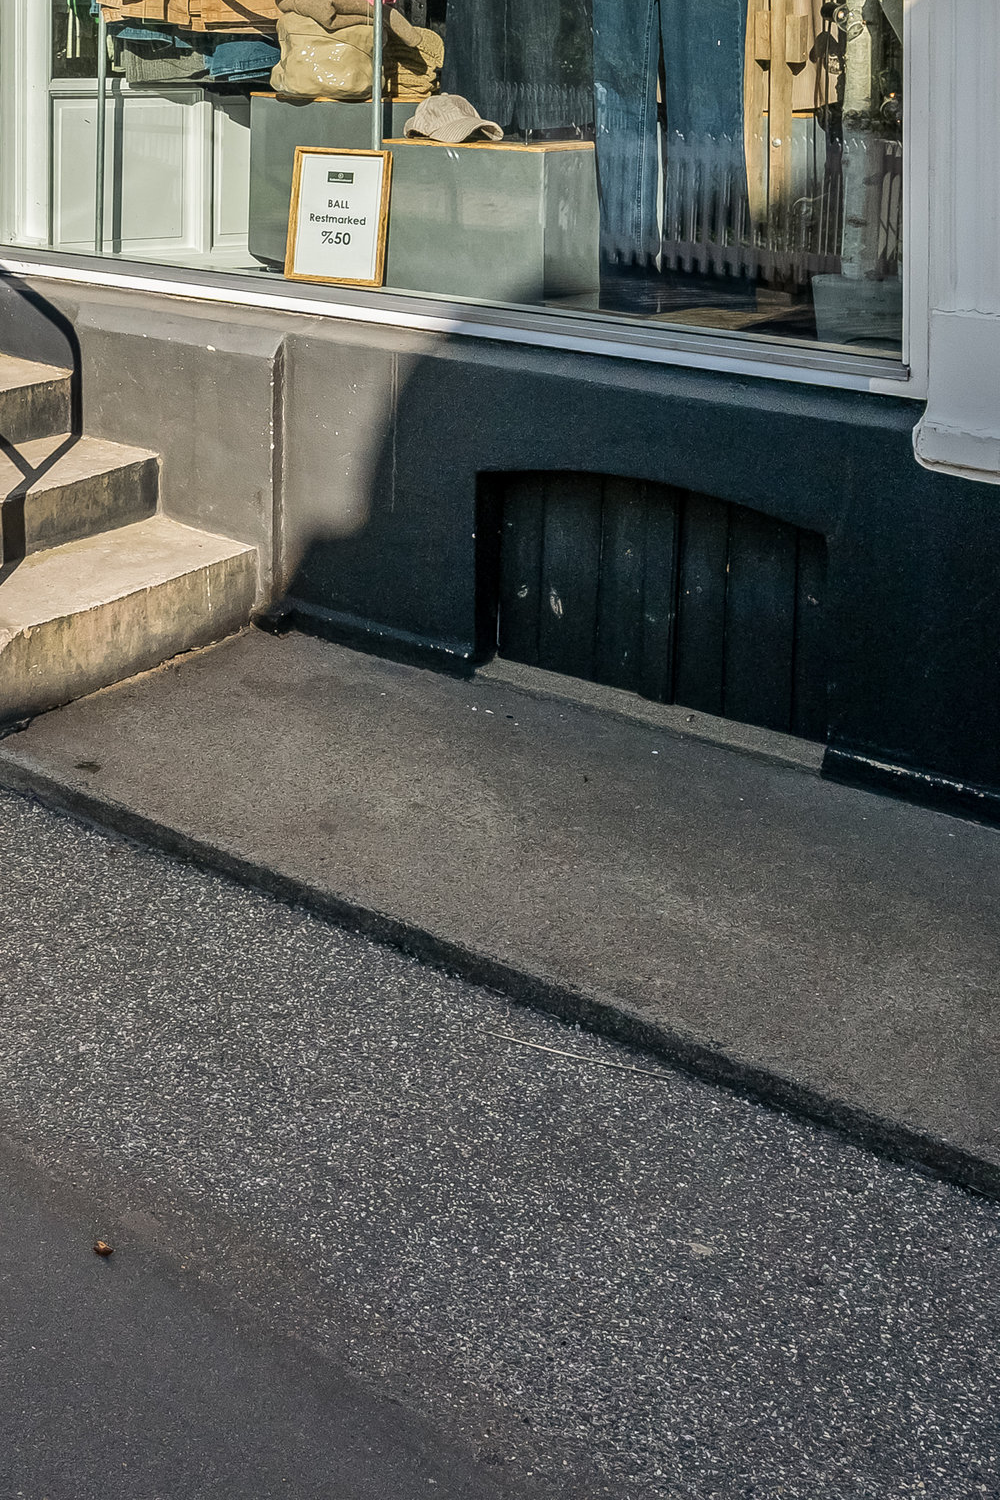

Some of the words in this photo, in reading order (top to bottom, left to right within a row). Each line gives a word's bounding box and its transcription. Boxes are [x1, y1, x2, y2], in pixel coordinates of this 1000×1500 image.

[327, 199, 350, 209] BALL
[309, 213, 366, 226] Restmarked
[321, 230, 351, 245] %50
